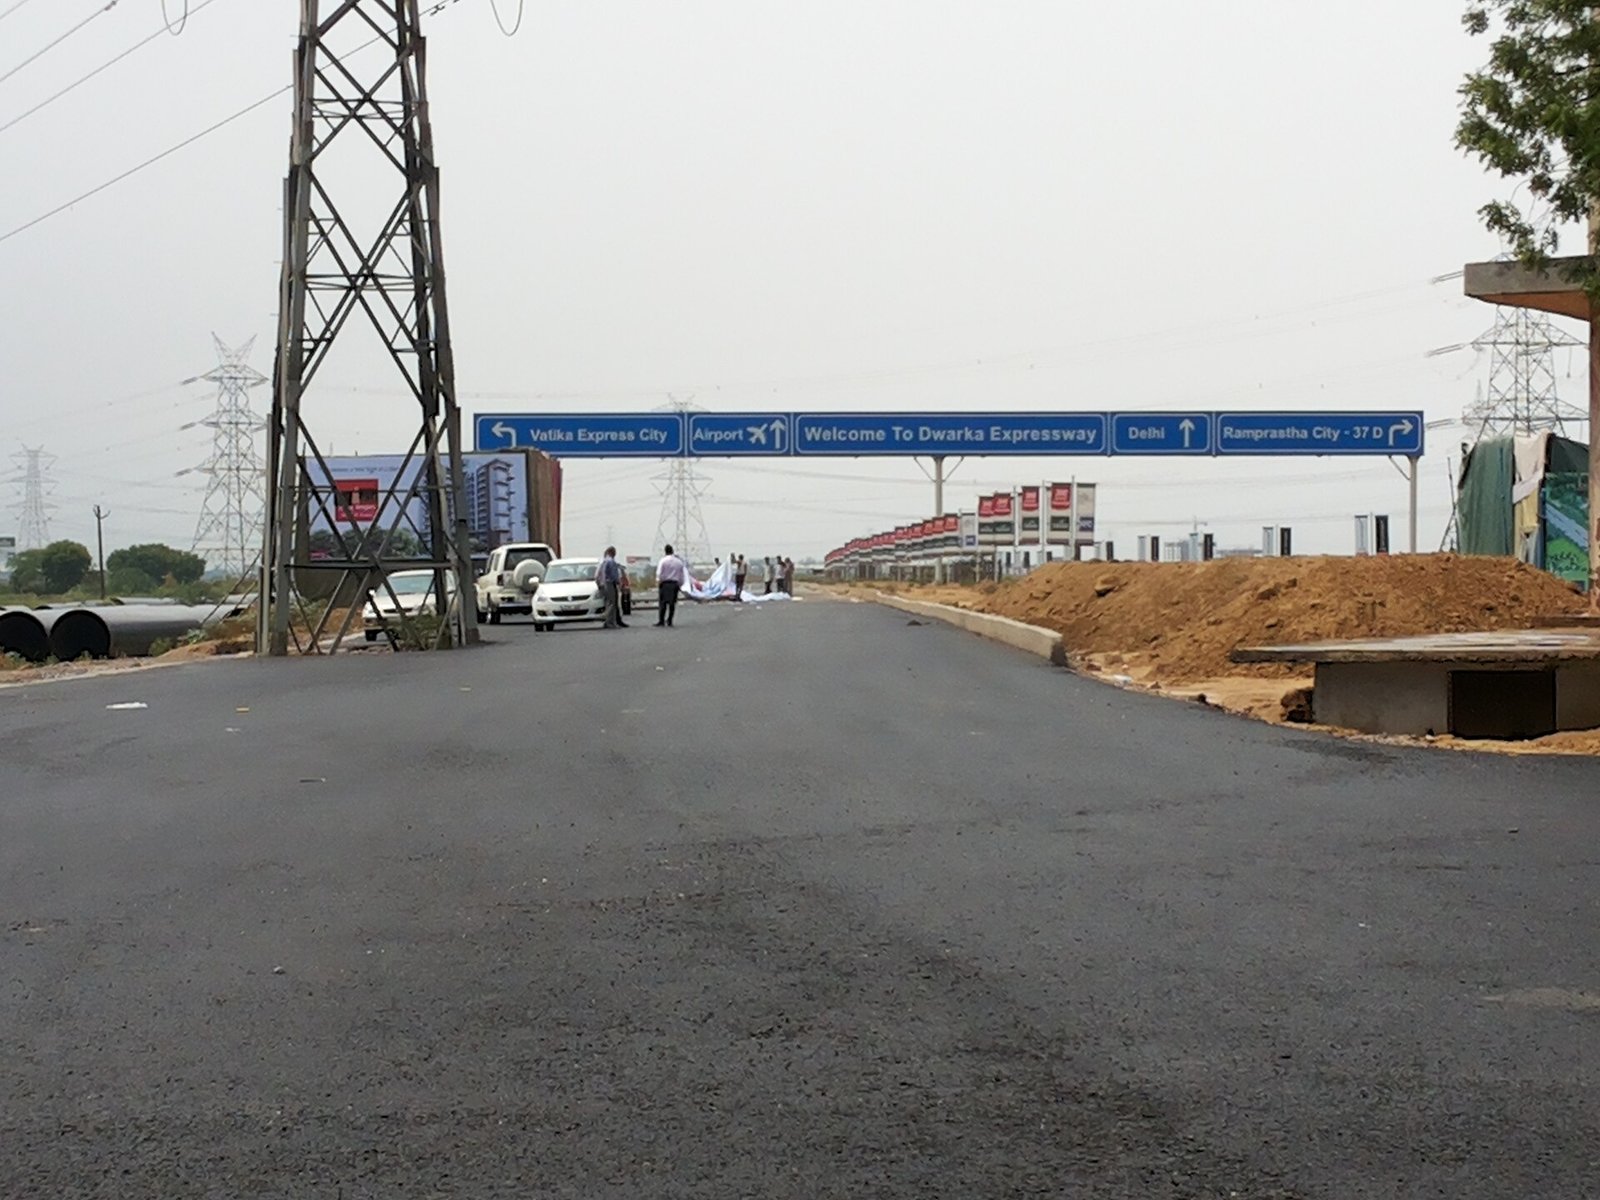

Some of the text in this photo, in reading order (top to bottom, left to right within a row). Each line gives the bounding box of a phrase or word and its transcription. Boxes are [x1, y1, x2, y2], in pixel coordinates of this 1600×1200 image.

[529, 427, 667, 444] Vatika Express City
[693, 427, 743, 443] Airport
[804, 426, 1097, 444] Welcome To Dwarka Expressway
[1128, 426, 1165, 440] Delhi
[1223, 426, 1308, 441] Ramprastha
[1312, 426, 1340, 442] City
[1353, 426, 1369, 439] 37
[1373, 426, 1383, 439] D
